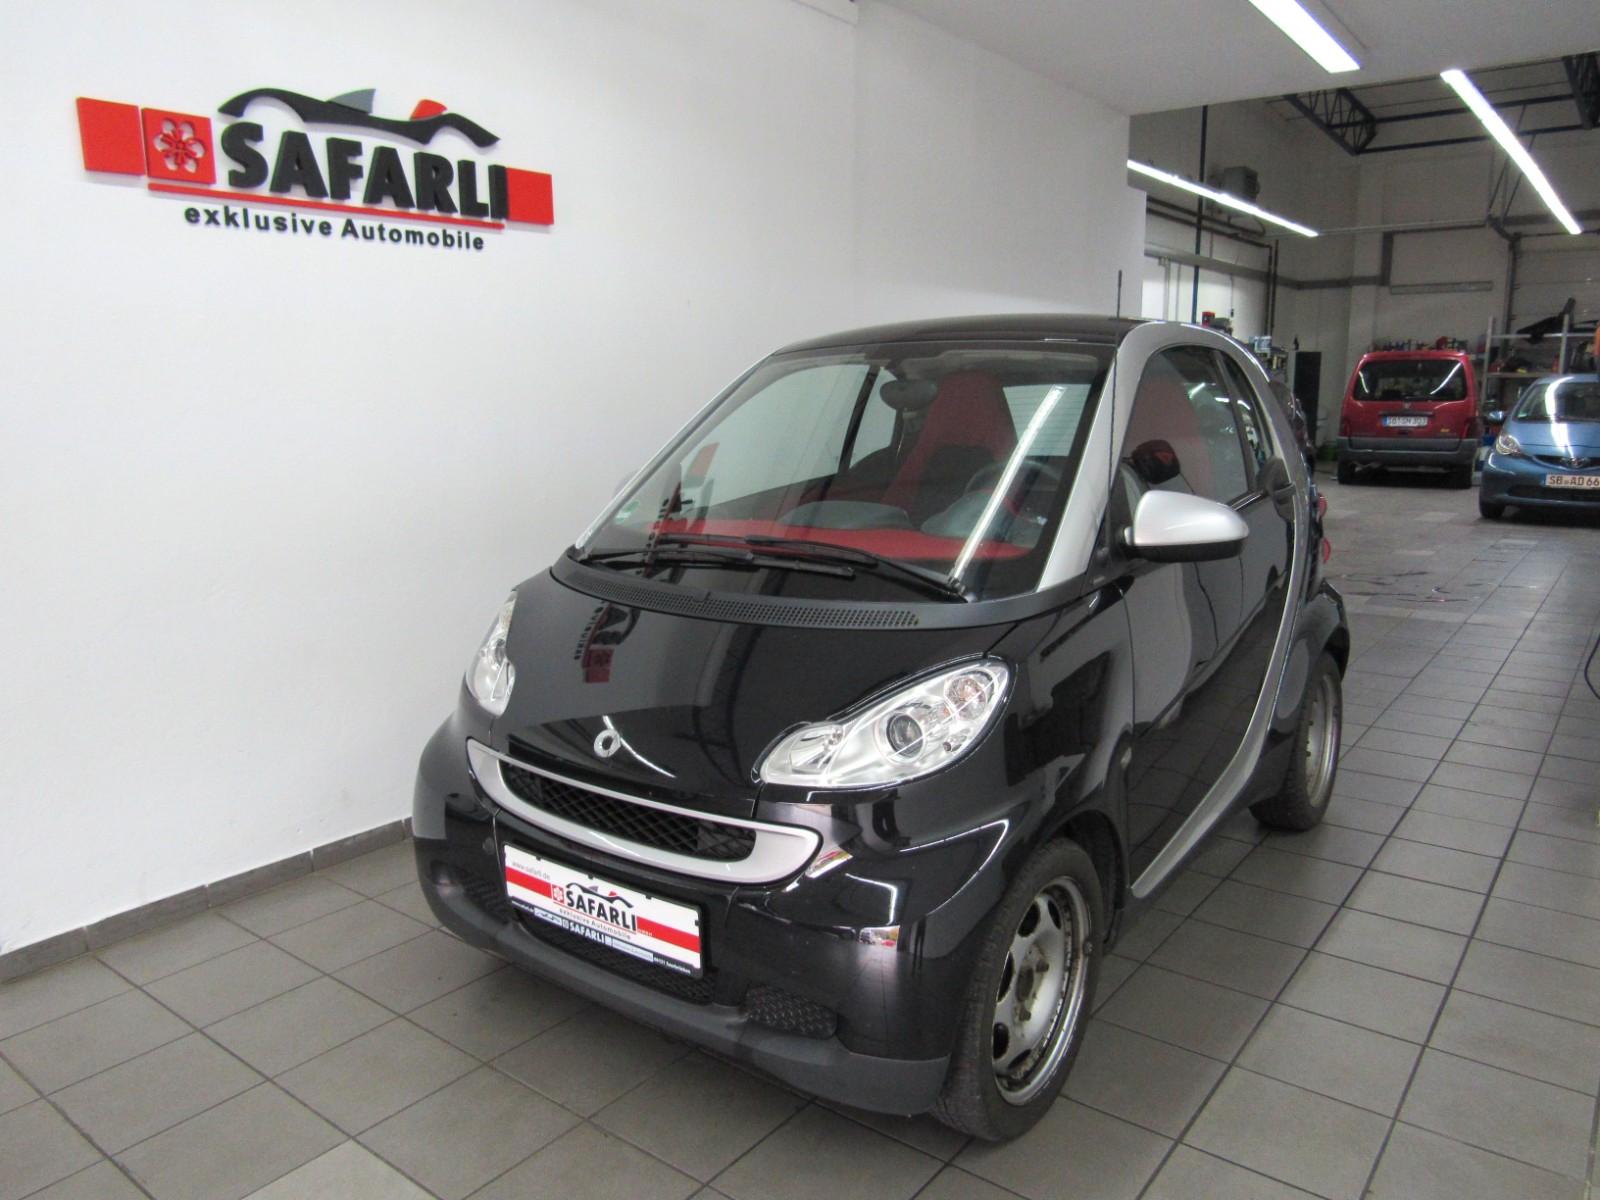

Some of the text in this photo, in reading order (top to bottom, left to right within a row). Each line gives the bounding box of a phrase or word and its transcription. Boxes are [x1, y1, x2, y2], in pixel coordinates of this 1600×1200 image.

[220, 121, 509, 220] SAFARLI
[184, 205, 485, 250] exklusive Automobile
[1549, 475, 1563, 485] SB
[566, 890, 637, 932] SAFARLI
[569, 921, 605, 943] SAFARLI
